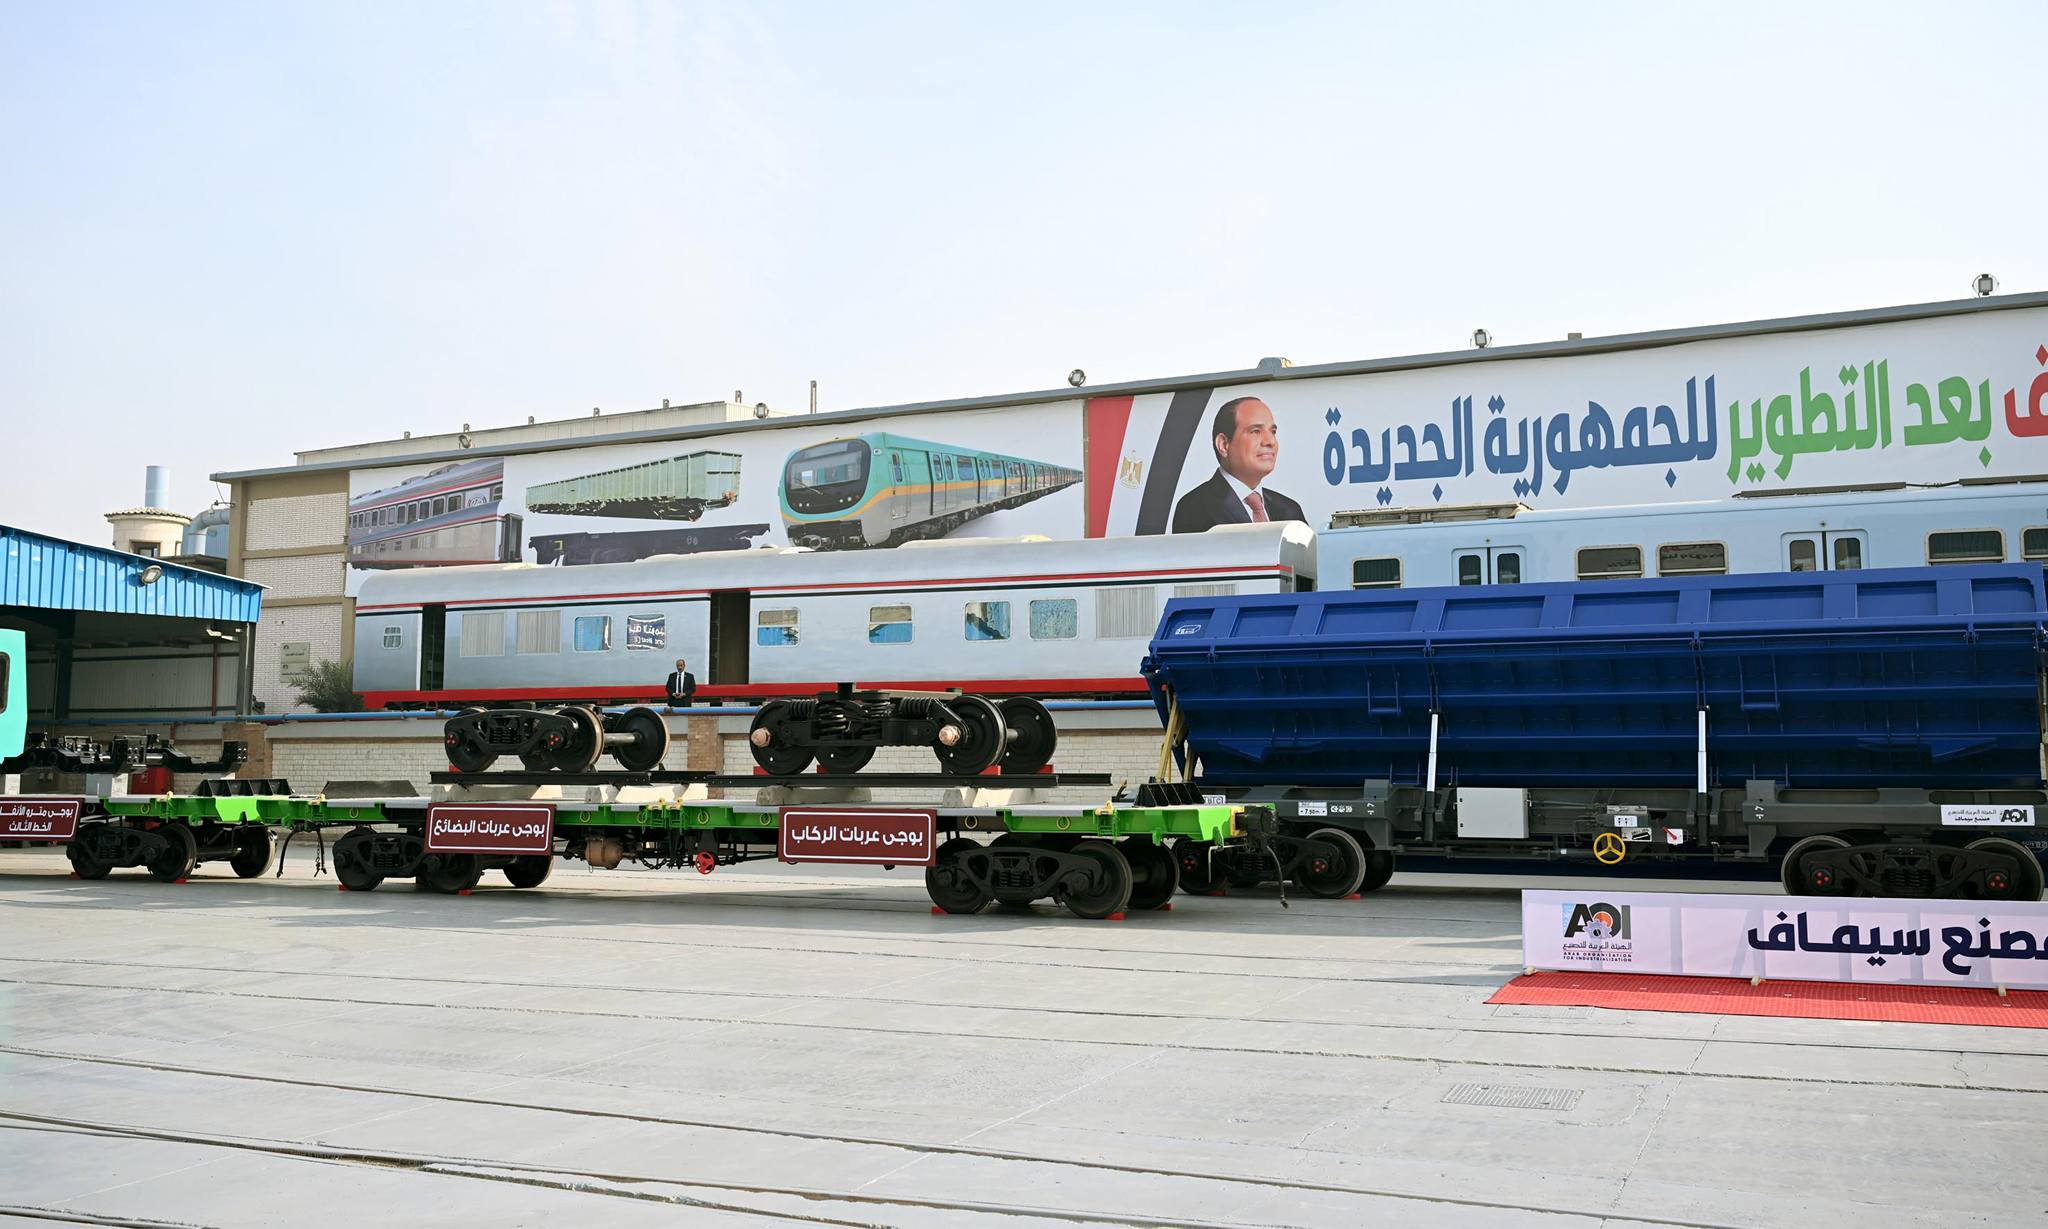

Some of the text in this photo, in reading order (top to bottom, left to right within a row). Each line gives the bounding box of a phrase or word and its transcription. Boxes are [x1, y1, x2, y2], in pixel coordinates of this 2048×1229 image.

[1727, 358, 1891, 484] التطوير
[1904, 375, 1991, 468] بعد
[1484, 374, 1717, 497] للجمهورية
[1323, 395, 1472, 504] الجديدة
[0, 804, 26, 816] الأنفا
[2000, 808, 2028, 823] AOI
[8, 820, 53, 832] الخط الثالث
[433, 819, 545, 838] بوجى عربات البضائع
[791, 825, 924, 847] بوجى عربات الركاب
[1563, 902, 1632, 940] AOI
[1562, 941, 1587, 951] للتصنيع
[1588, 941, 1609, 951] العربية
[1747, 911, 1931, 967] سيماف
